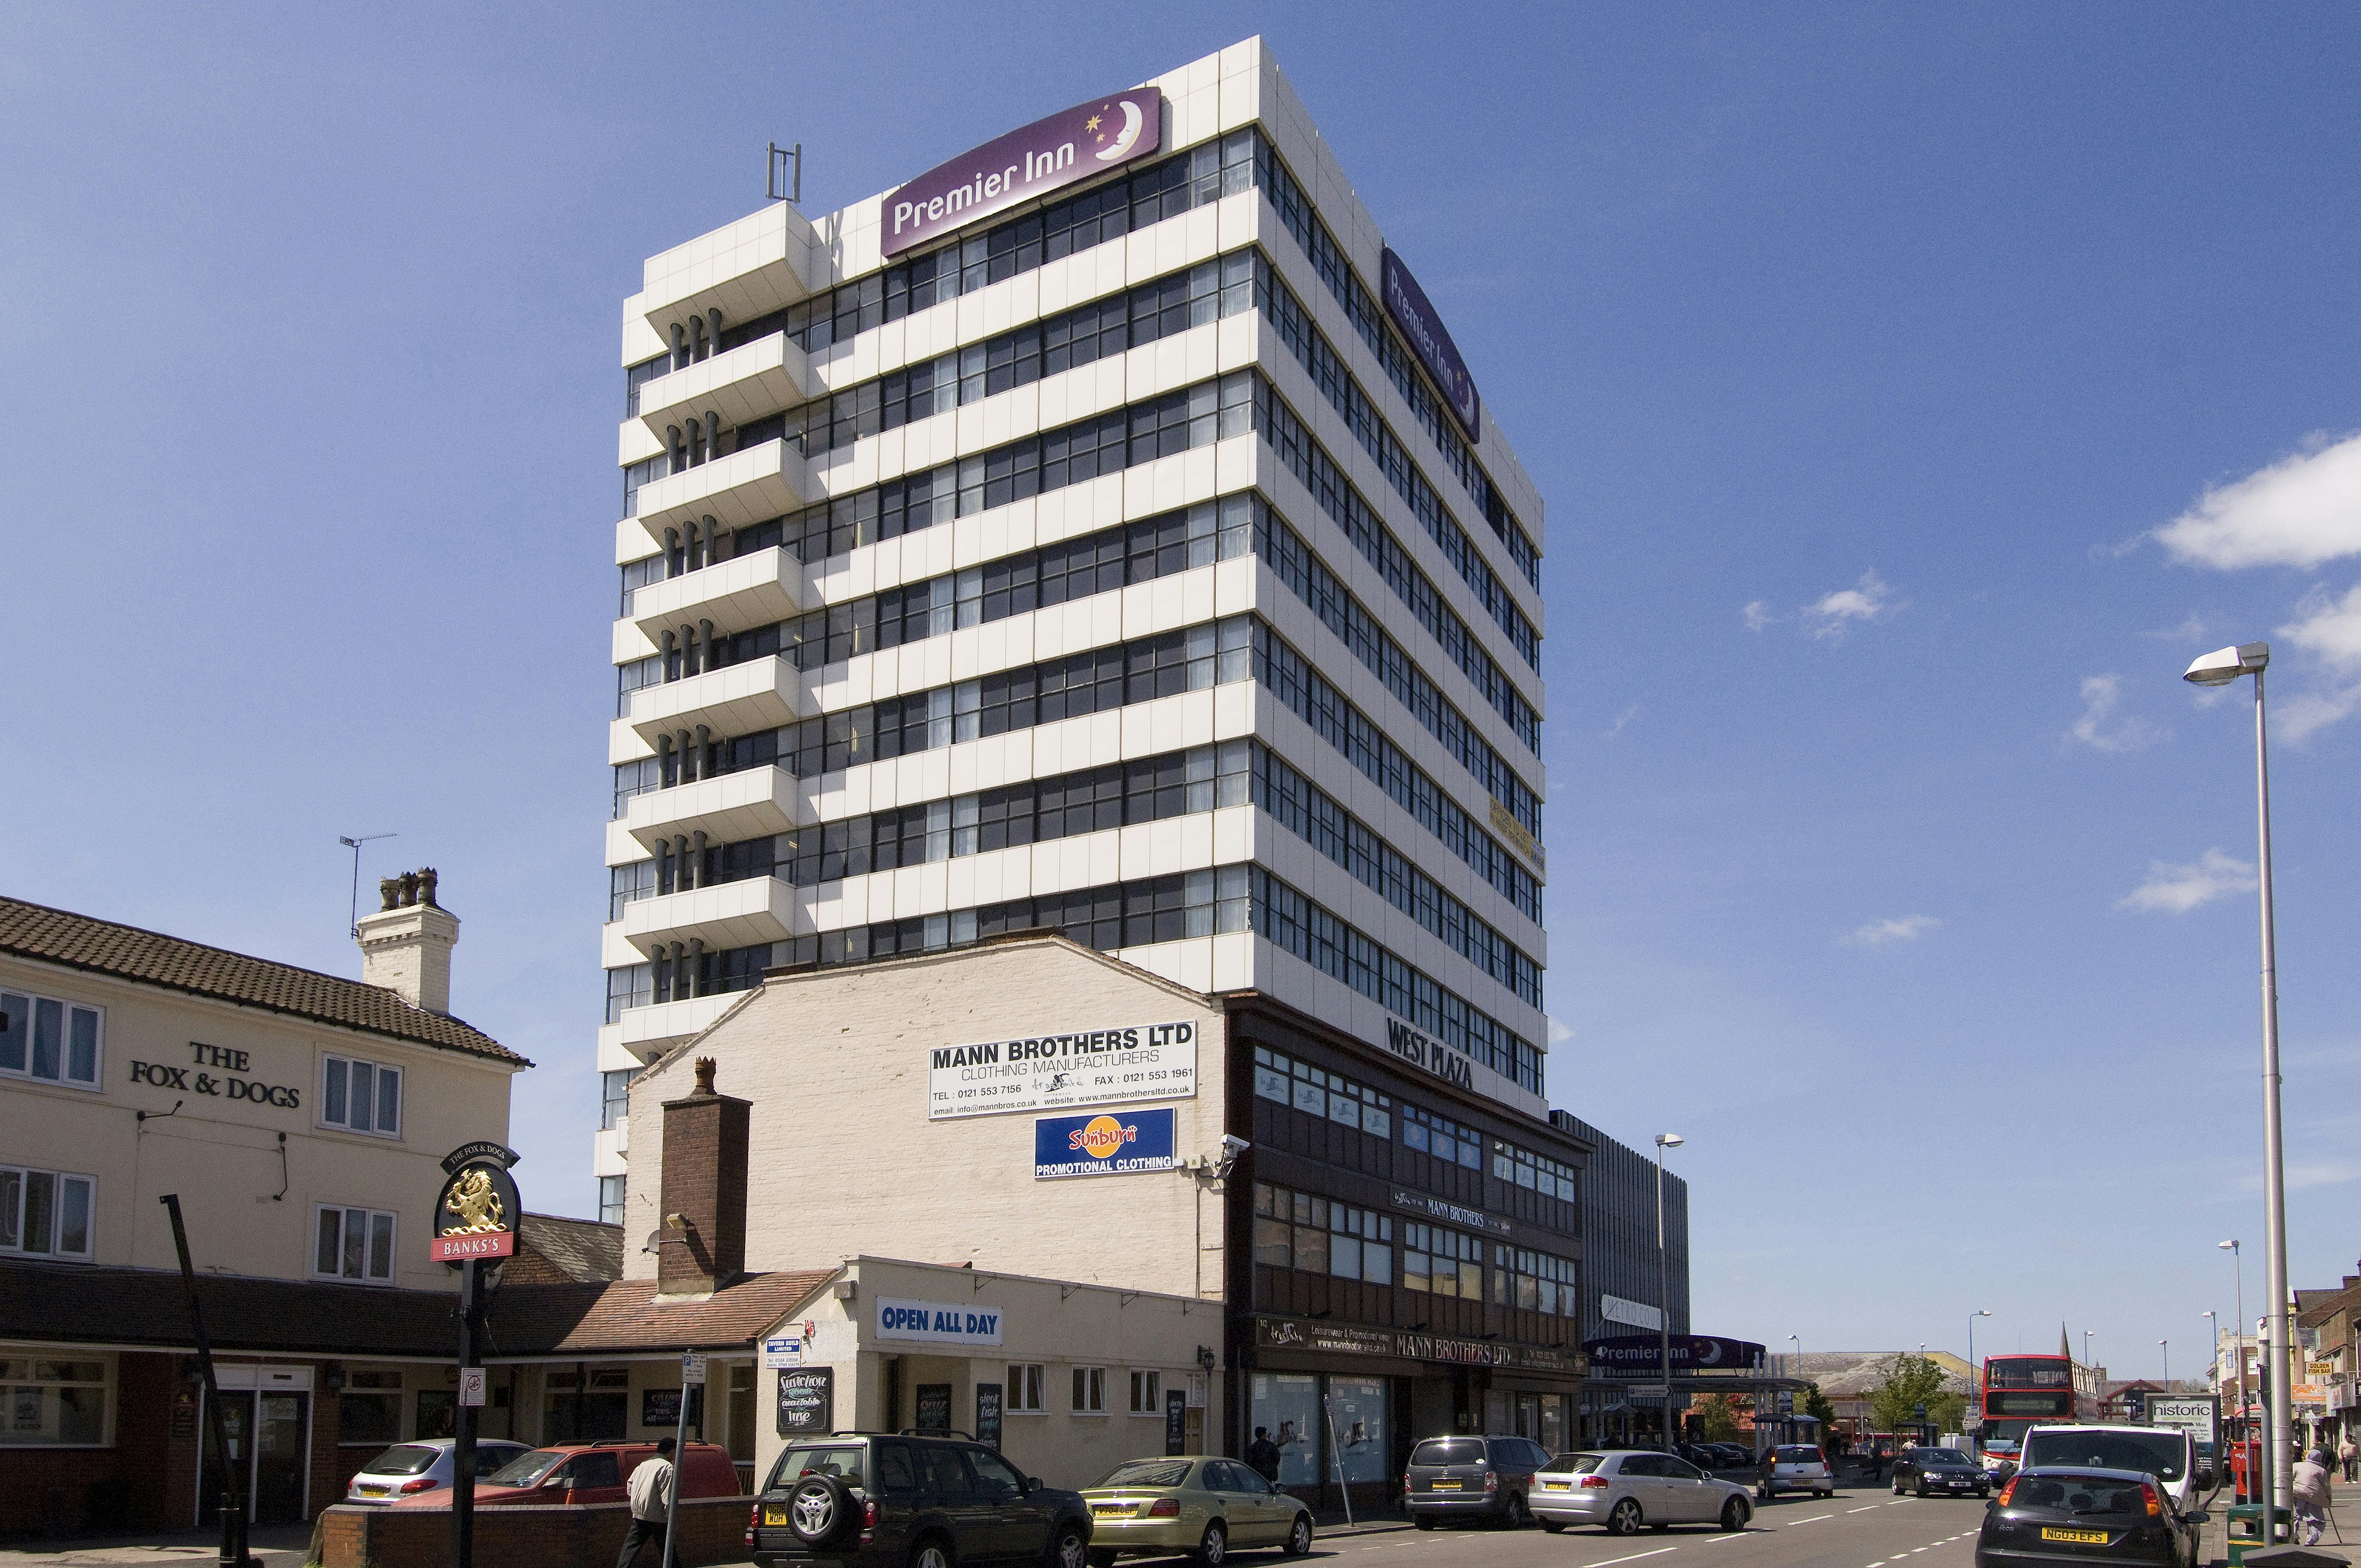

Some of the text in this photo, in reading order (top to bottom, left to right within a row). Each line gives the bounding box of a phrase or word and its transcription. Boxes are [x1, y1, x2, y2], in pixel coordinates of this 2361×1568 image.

[894, 143, 1074, 235] Premier Inn
[1391, 266, 1453, 391] Premier Inn
[189, 1042, 249, 1072] THE
[933, 1023, 1192, 1069] MANN BROTHERS LTD
[1387, 1017, 1473, 1091] WEST PLAZA
[962, 1049, 1159, 1081] CLOTHING MANUFACTURERS
[1123, 1073, 1144, 1082] 0121
[1149, 1070, 1167, 1080] 553
[1172, 1068, 1193, 1078] 1961
[130, 1060, 300, 1108] FOX & DOGS
[958, 1089, 976, 1098] 0121
[981, 1087, 997, 1096] 553
[1001, 1085, 1021, 1094] 7156
[958, 1101, 1037, 1113] info@mannbros.co.uk
[1045, 1096, 1075, 1105] website:
[1079, 1086, 1189, 1102] www.mannbrothersltd.co.uk
[449, 1152, 465, 1164] THE
[464, 1145, 479, 1155] FOX
[487, 1145, 505, 1159] DOGS
[1036, 1156, 1171, 1175] PROMOTIONAL CLOTHING
[1428, 1199, 1448, 1218] MANN
[1450, 1205, 1483, 1228] BROTHERS
[444, 1238, 498, 1255] BANKS'S
[882, 1306, 998, 1335] OPEN ALL DAY
[1608, 1298, 1660, 1327] METRO COUR
[1311, 1325, 1343, 1337] Leisurewear
[1349, 1330, 1378, 1341] Promotional
[1397, 1335, 1510, 1365] MANN BROTHERS LTD
[1596, 1346, 1689, 1360] Premier nn
[2153, 1404, 2210, 1415] historic
[2046, 1529, 2103, 1542] NG03 EFS
